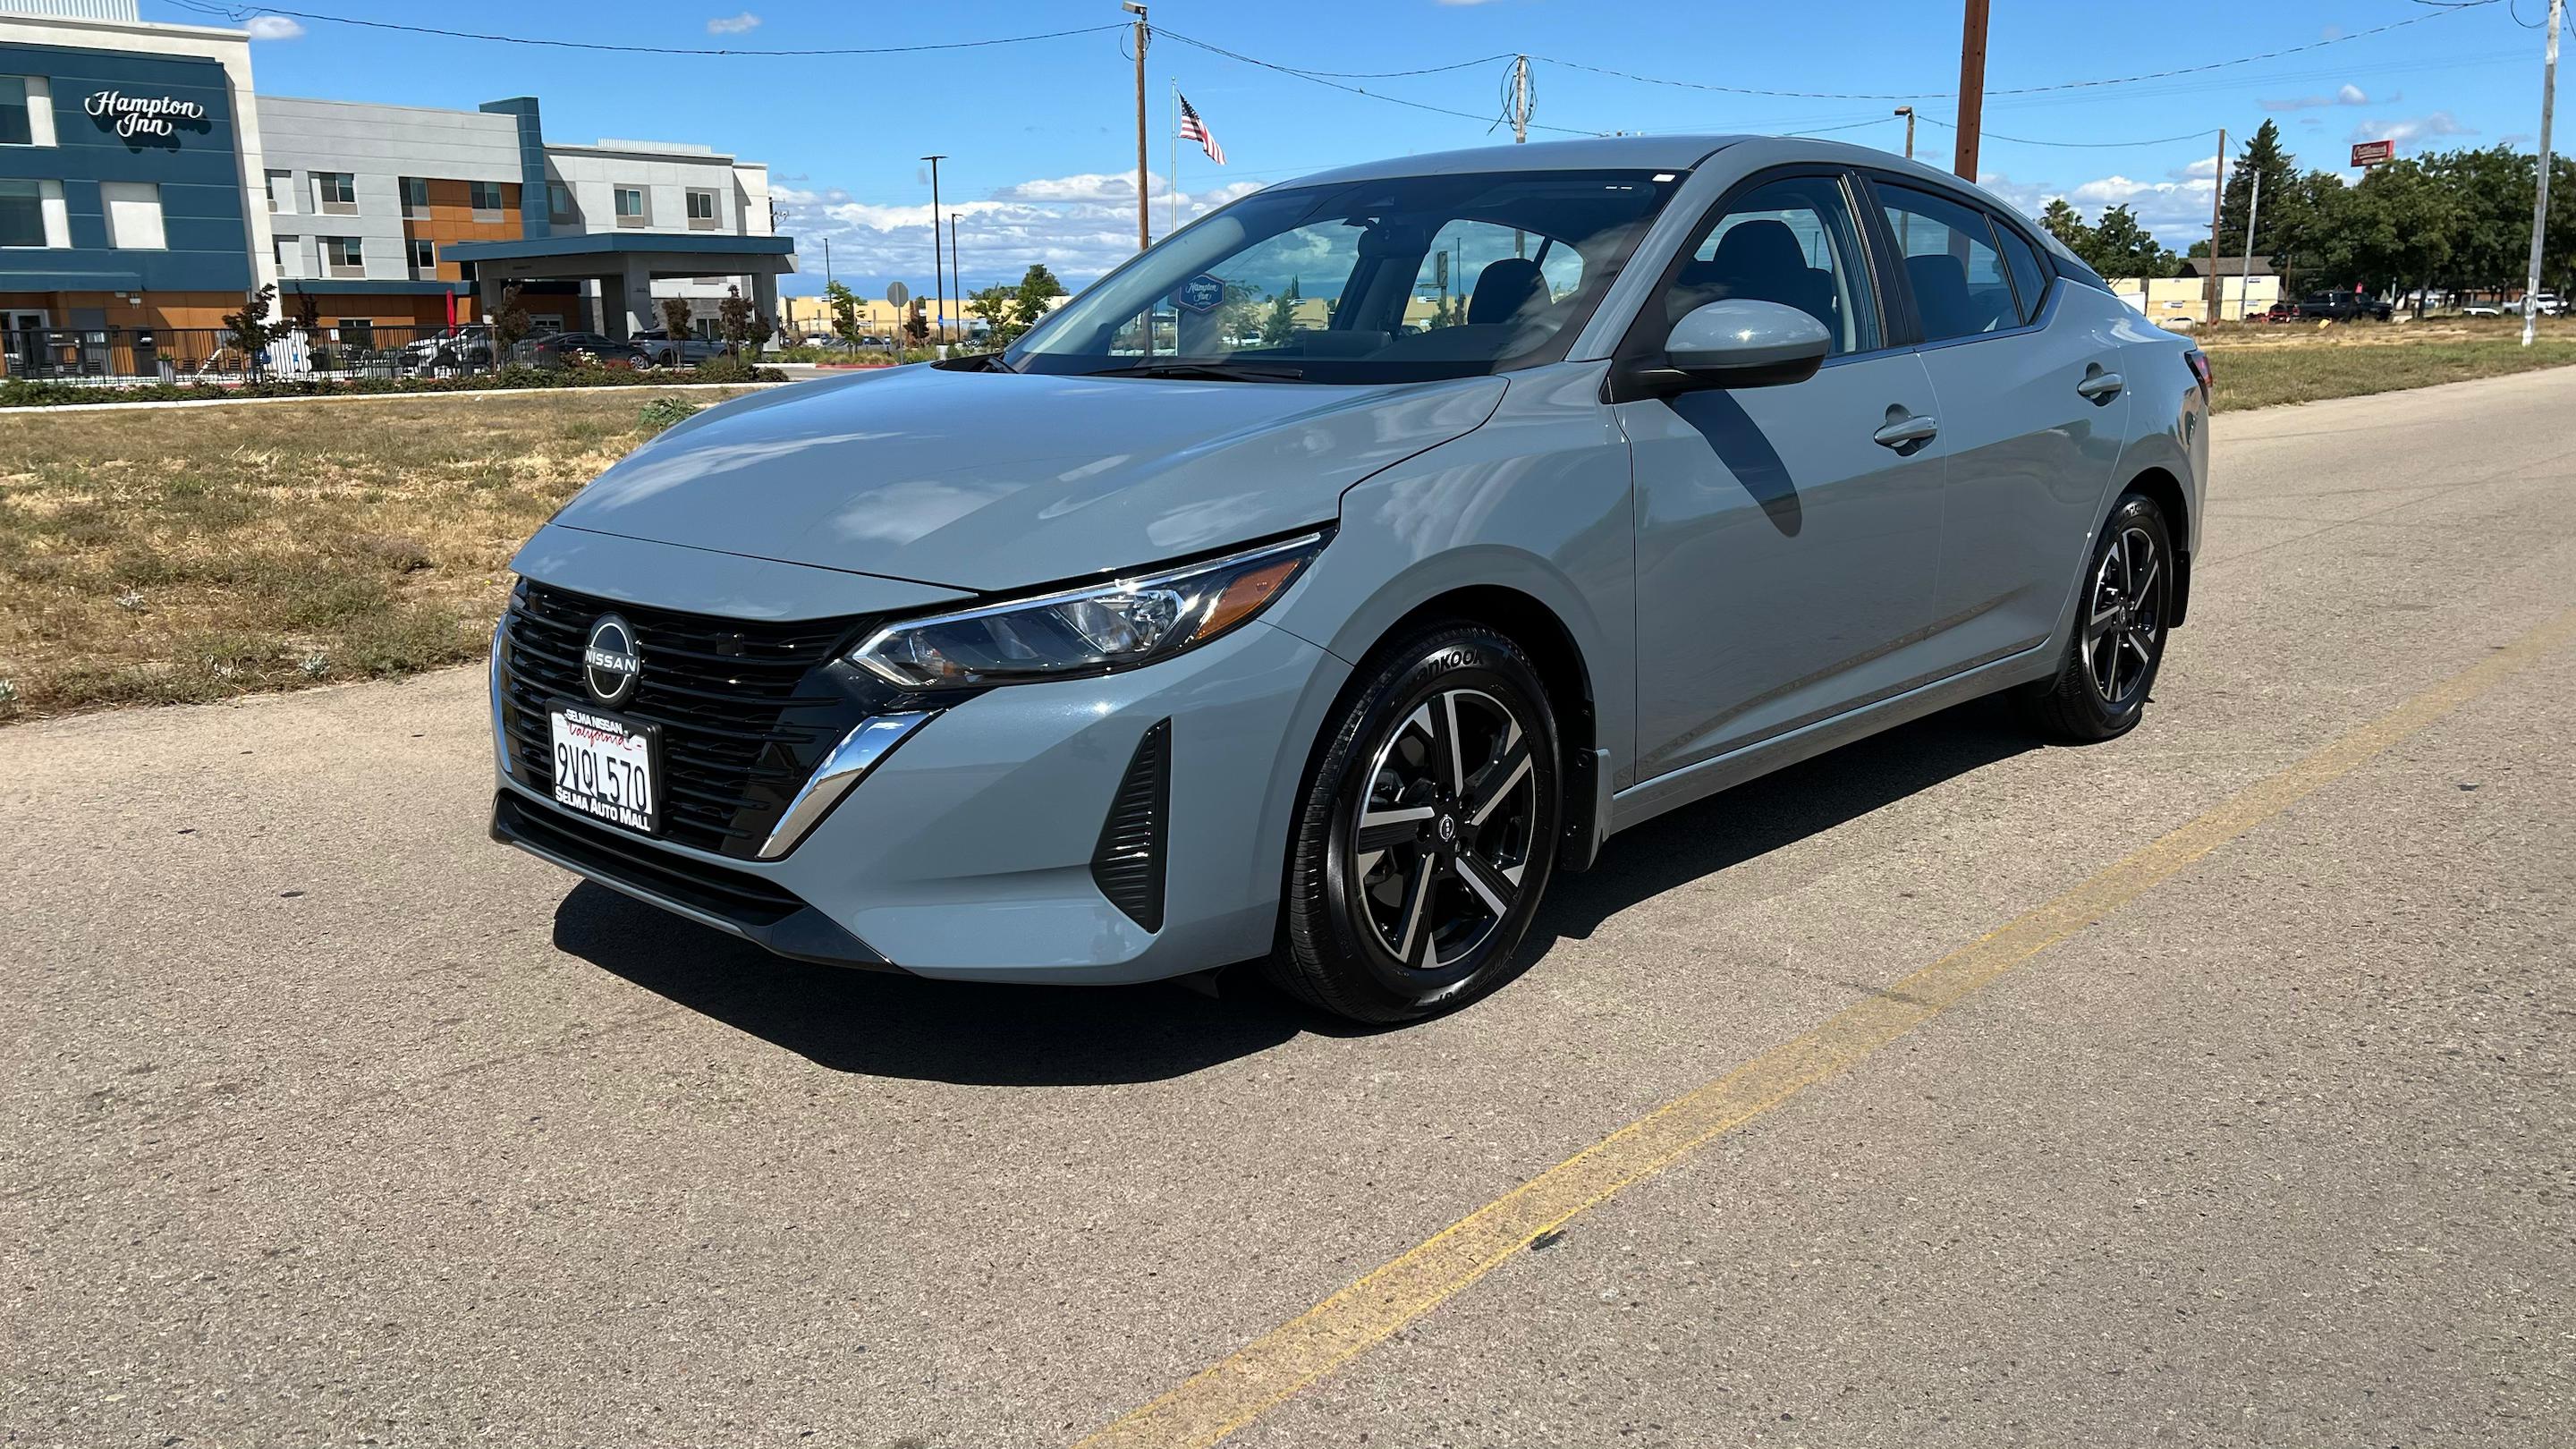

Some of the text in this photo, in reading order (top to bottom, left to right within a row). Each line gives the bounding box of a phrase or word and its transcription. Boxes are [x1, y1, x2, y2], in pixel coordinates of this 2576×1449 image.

[84, 90, 203, 118] Hampton
[116, 113, 173, 138] Inn
[1185, 282, 1219, 293] Hampton
[585, 649, 636, 673] NISSAN
[564, 708, 623, 734] SELMA NISSAN
[558, 742, 647, 813] 9VQL570
[555, 786, 651, 832] SELMA AUTO MALL
